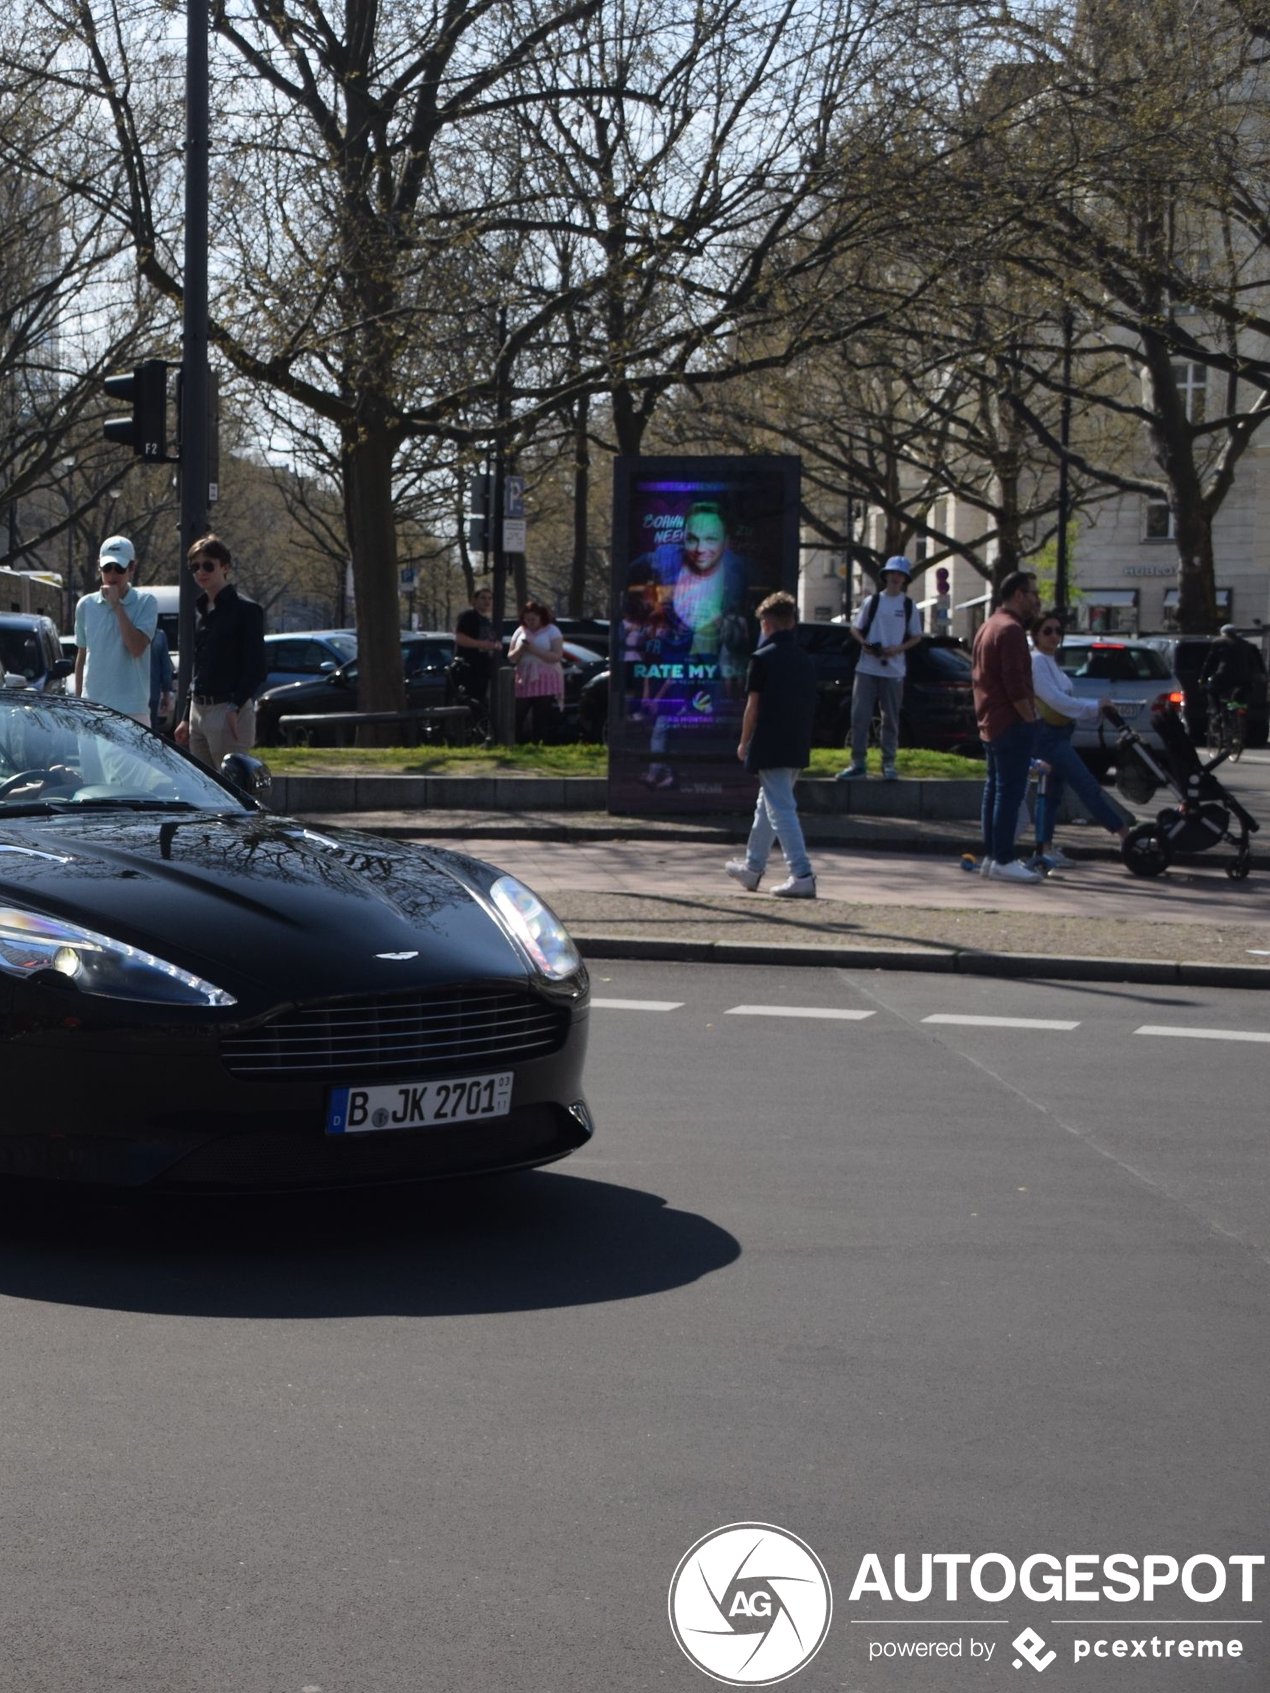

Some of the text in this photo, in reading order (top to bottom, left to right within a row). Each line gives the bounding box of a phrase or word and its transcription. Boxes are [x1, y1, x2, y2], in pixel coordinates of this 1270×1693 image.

[145, 443, 157, 454] F2
[634, 664, 683, 678] RATE
[689, 664, 717, 678] MY
[499, 1076, 510, 1087] 03
[333, 1079, 495, 1127] D B JK 2701
